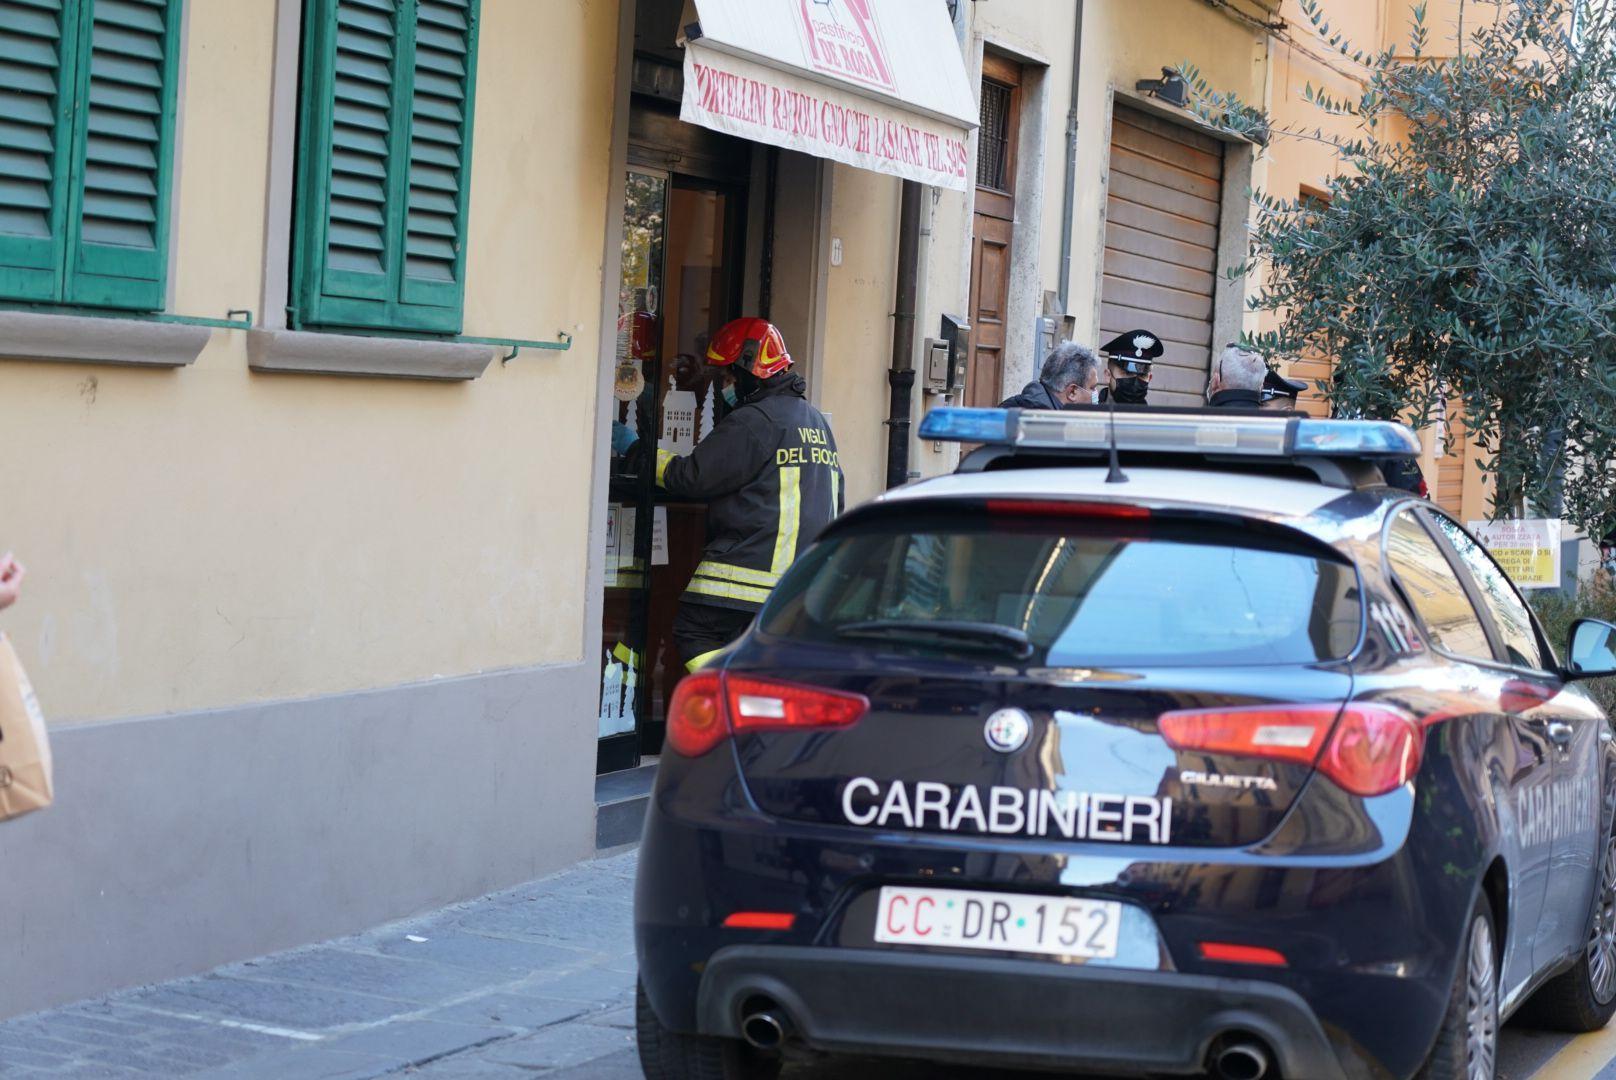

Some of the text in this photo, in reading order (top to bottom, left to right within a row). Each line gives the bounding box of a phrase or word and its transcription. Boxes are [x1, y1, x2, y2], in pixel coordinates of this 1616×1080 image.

[818, 38, 841, 67] DE
[693, 63, 767, 126] TORTELLINI
[772, 86, 818, 139] RAVIOLI
[821, 100, 870, 154] GNOCCHI
[874, 117, 922, 167] LASAGNE
[776, 447, 807, 464] DEL
[1180, 770, 1278, 791] GIULIETTA
[841, 776, 1173, 844] CARABINIERI
[1517, 777, 1592, 850] CARABINIERI
[886, 895, 1109, 950] CC DR 152
